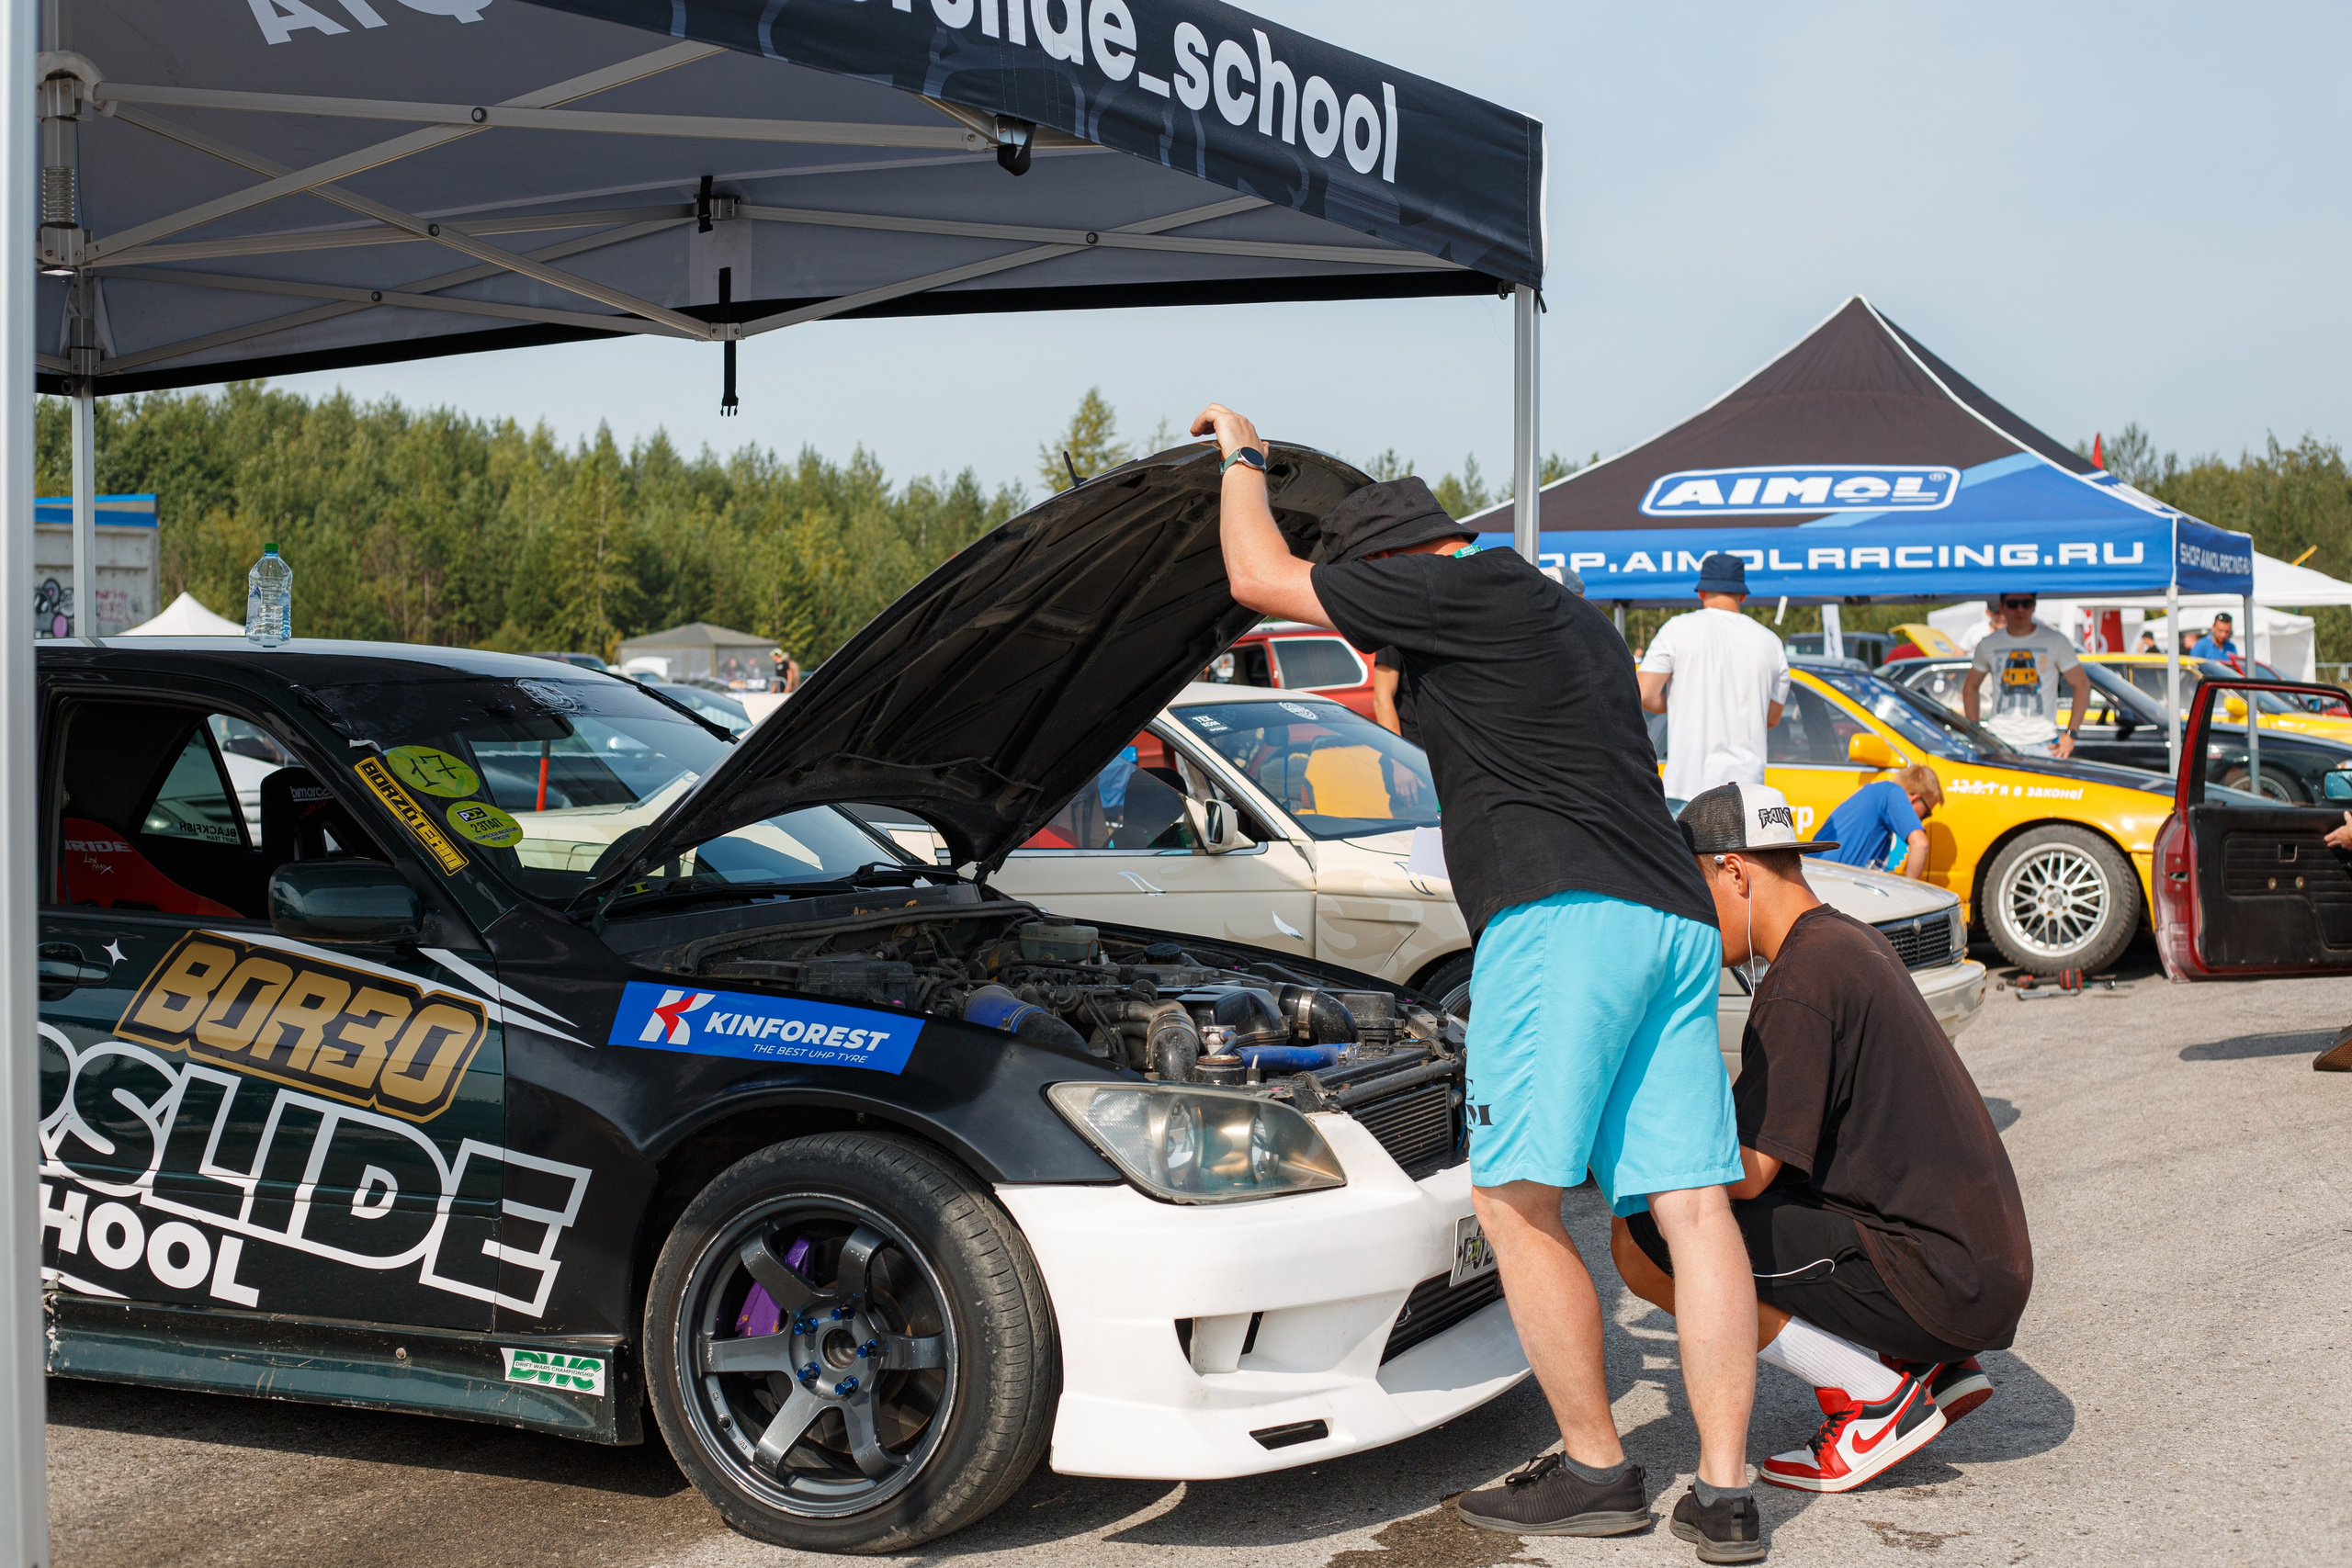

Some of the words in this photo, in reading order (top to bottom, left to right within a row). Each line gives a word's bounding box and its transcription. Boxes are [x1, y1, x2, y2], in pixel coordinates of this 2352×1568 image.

[1657, 476, 1939, 506] AIMOL
[411, 754, 457, 787] 17
[2026, 787, 2084, 800] законе!
[470, 824, 481, 833] 2
[477, 818, 503, 831] ЭТАП
[704, 1011, 890, 1052] KINFOREST
[752, 1043, 774, 1055] THE
[776, 1045, 808, 1056] BEST
[808, 1050, 836, 1060] UHP
[838, 1053, 868, 1064] TYRE
[508, 1350, 603, 1391] DWC
[551, 1367, 594, 1378] CHAMPIONSHIP
